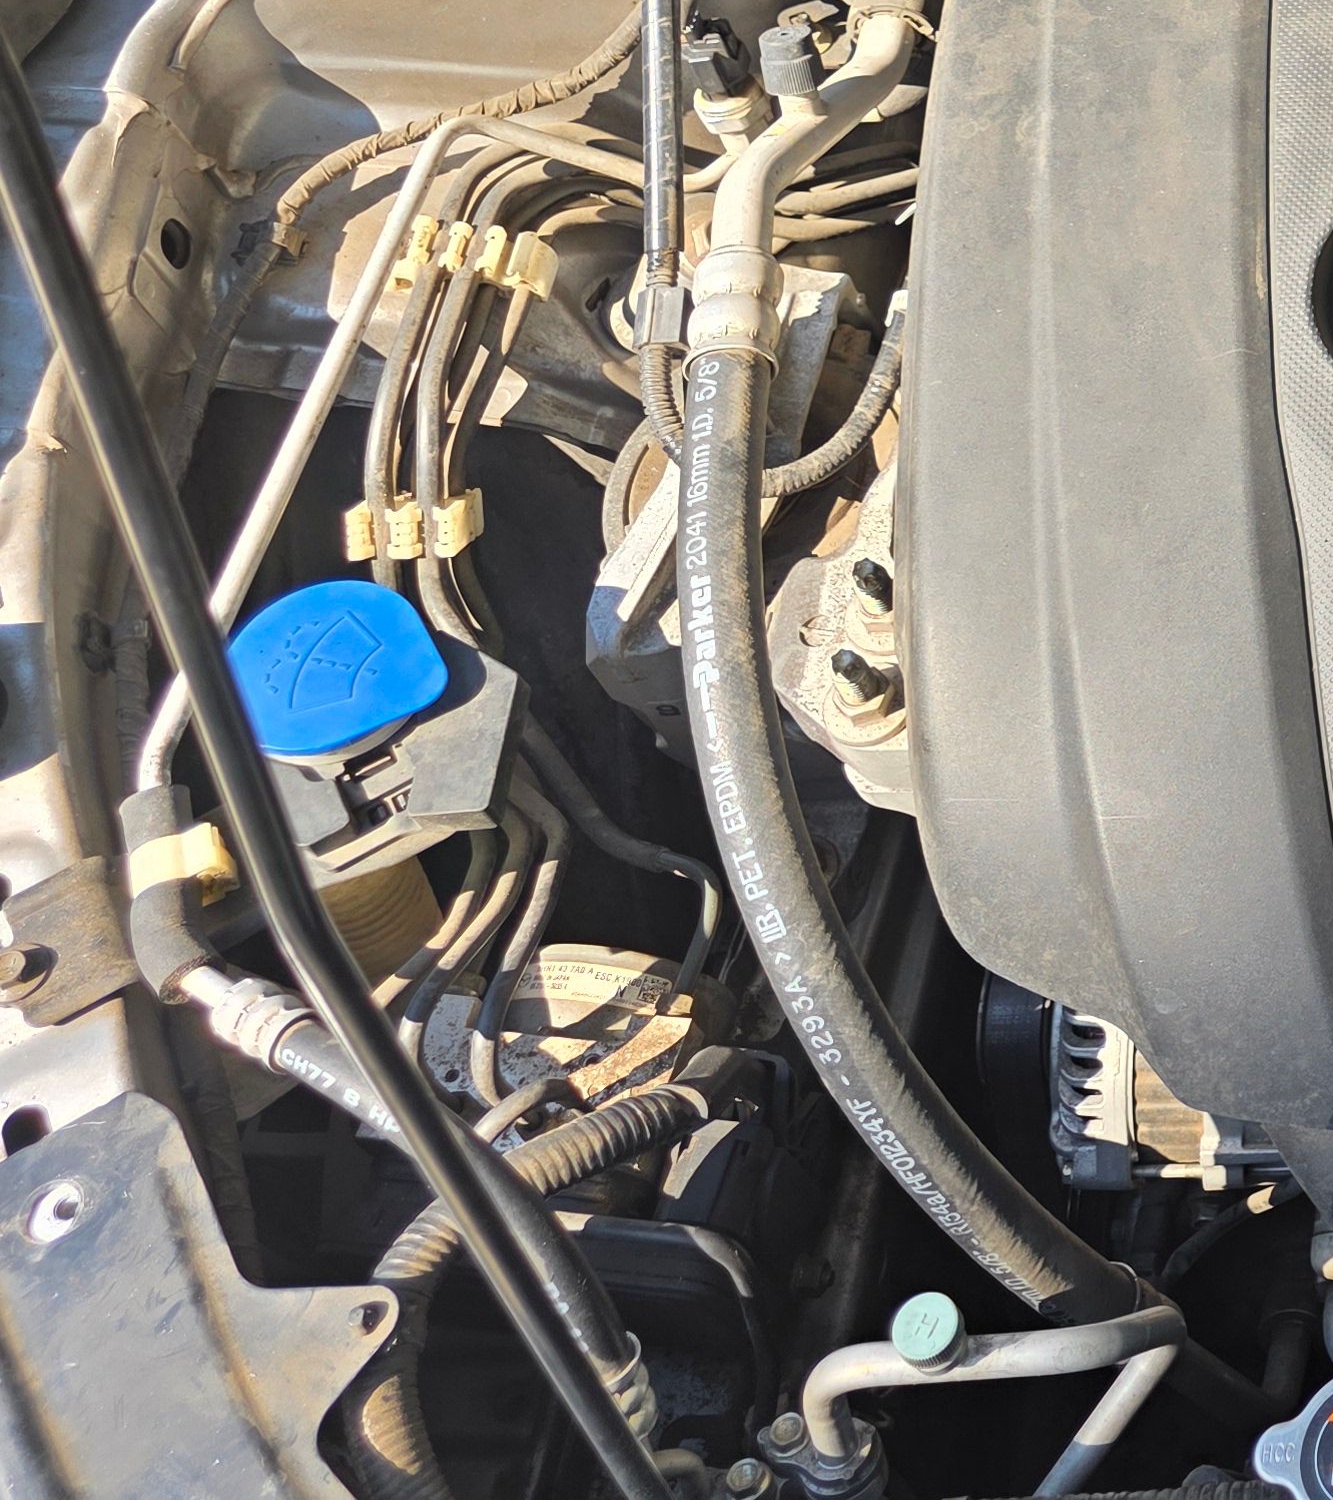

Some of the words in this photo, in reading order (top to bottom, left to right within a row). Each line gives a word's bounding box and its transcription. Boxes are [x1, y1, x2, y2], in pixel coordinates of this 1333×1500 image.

[686, 443, 711, 507] 16mm
[685, 510, 708, 570] 2041
[687, 574, 720, 690] Parker
[709, 759, 747, 835] EPDM
[784, 975, 843, 1065] 3293A
[281, 1048, 337, 1089] CH77
